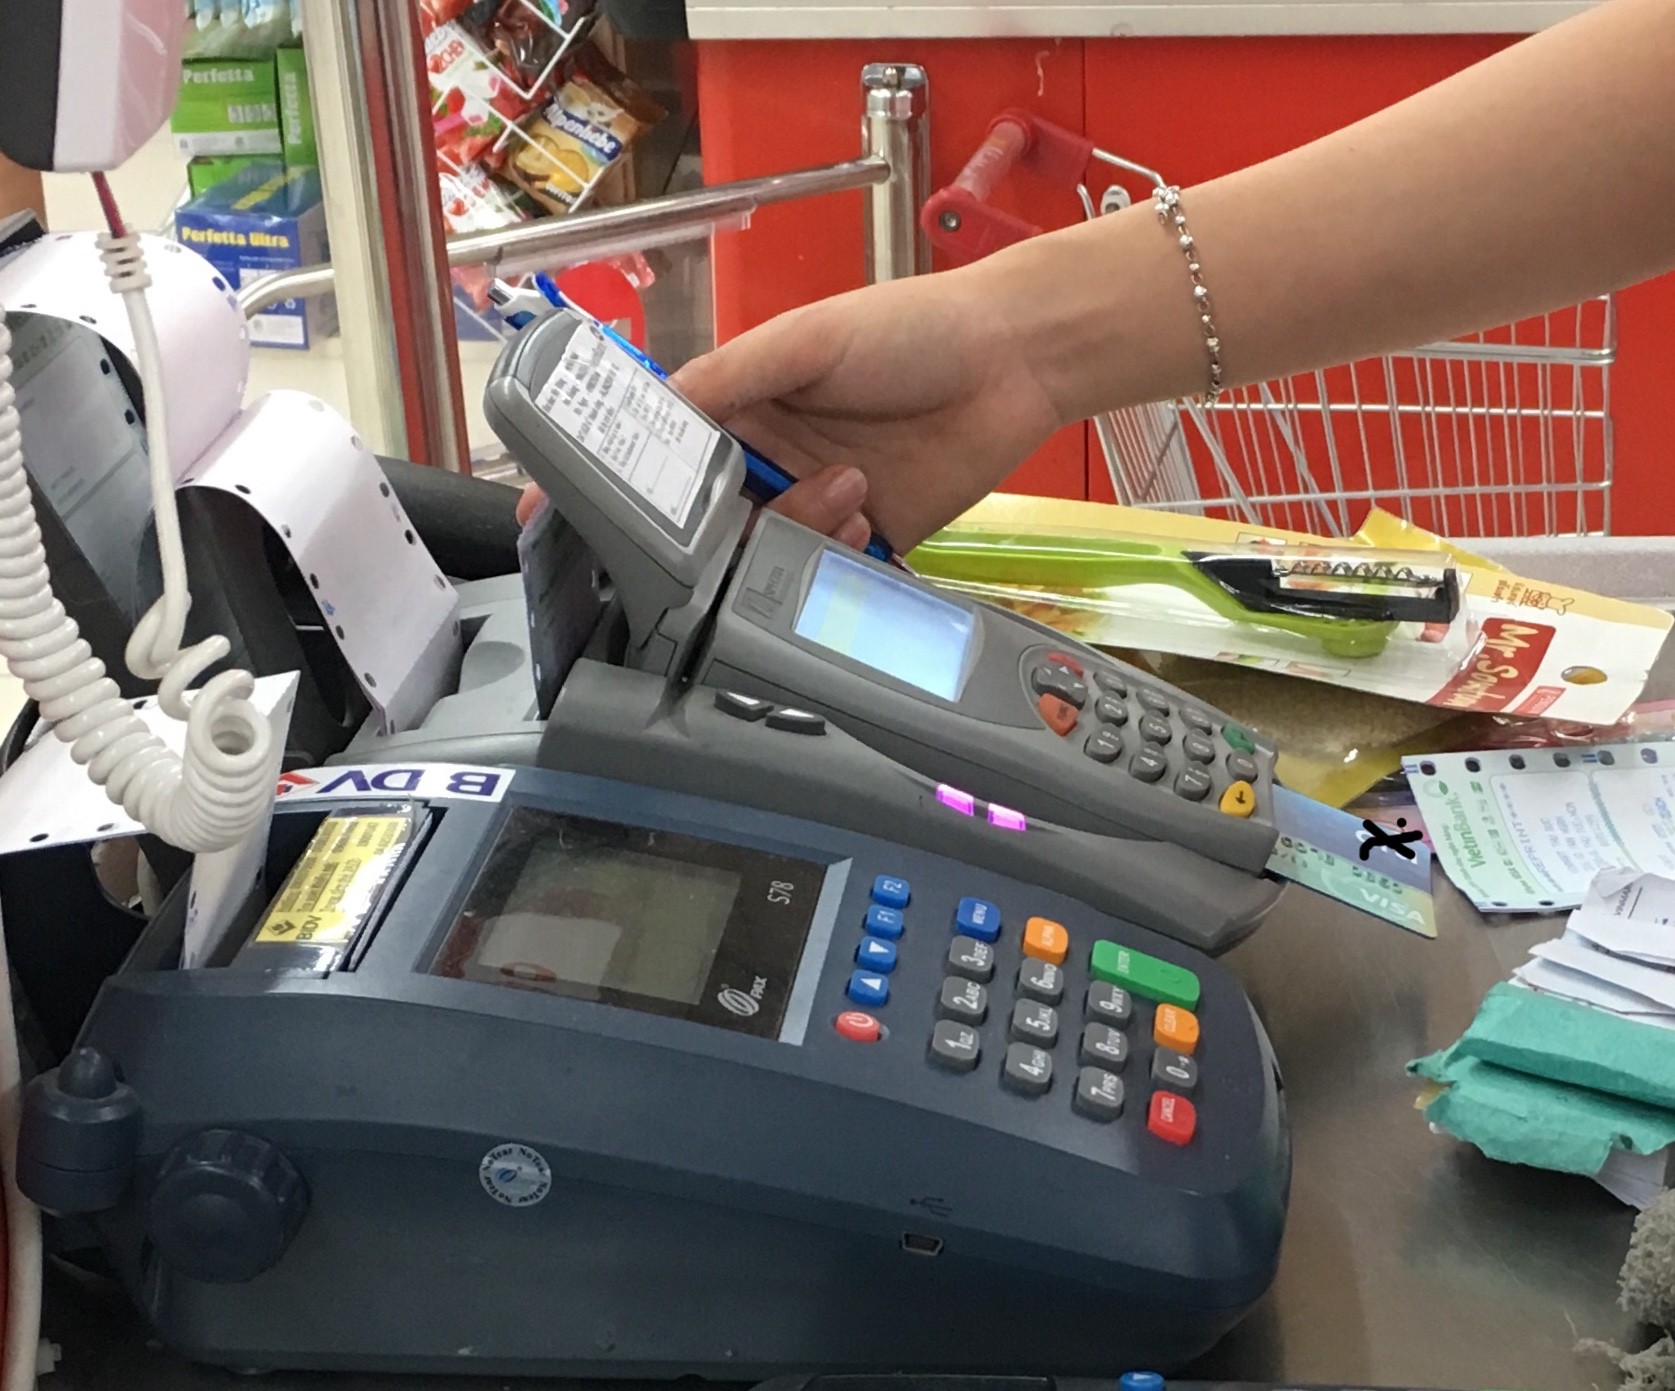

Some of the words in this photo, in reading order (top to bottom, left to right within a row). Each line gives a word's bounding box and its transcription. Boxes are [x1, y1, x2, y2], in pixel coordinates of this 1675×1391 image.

[182, 69, 255, 84] Perfetta
[284, 72, 301, 144] Perfetta
[544, 99, 617, 155] Alpenliebe
[181, 226, 247, 246] Perfetta
[249, 232, 290, 248] Ultra
[767, 880, 794, 905] S78
[883, 880, 902, 894] F2
[877, 911, 896, 924] F1
[972, 903, 988, 925] MENU
[1360, 888, 1427, 926] VISA
[295, 914, 323, 941] BIDV
[750, 975, 768, 1000] PAX
